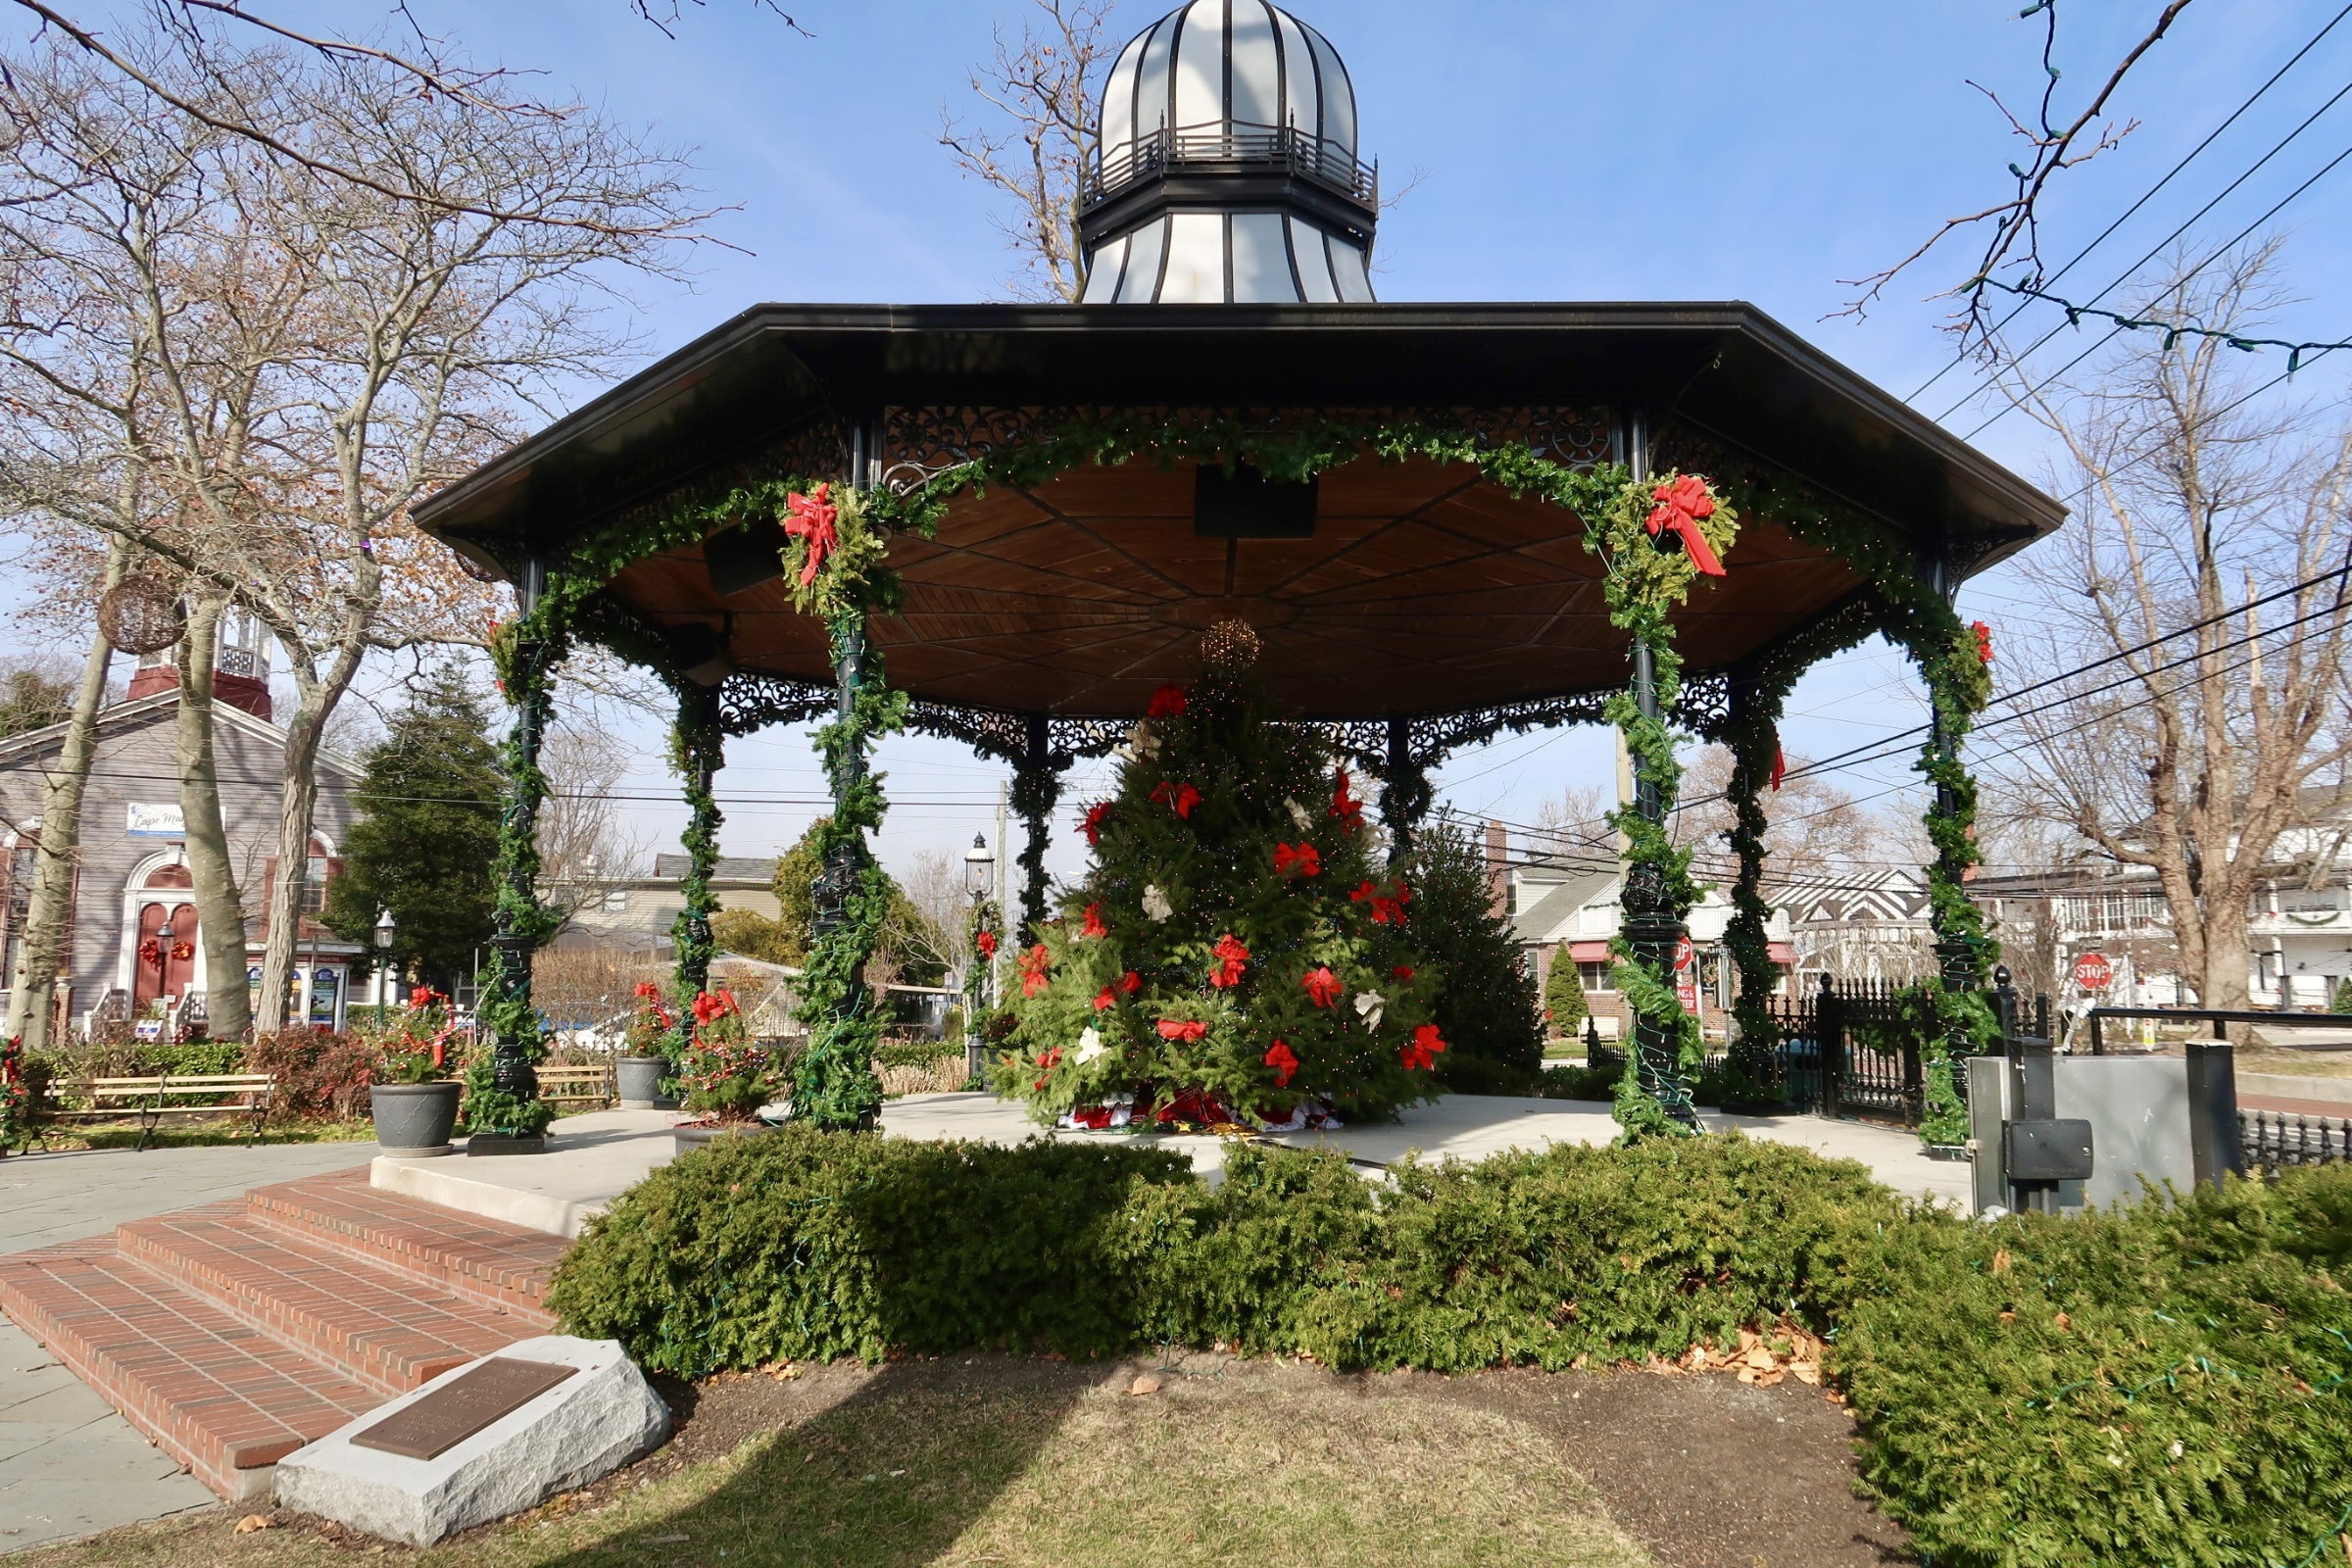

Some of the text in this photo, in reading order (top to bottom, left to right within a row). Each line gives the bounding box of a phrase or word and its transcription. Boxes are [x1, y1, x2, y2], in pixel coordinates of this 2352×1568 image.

[133, 814, 161, 829] Cape
[1676, 944, 1690, 959] OP
[2077, 964, 2109, 978] STOP
[1679, 999, 1695, 1009] TER
